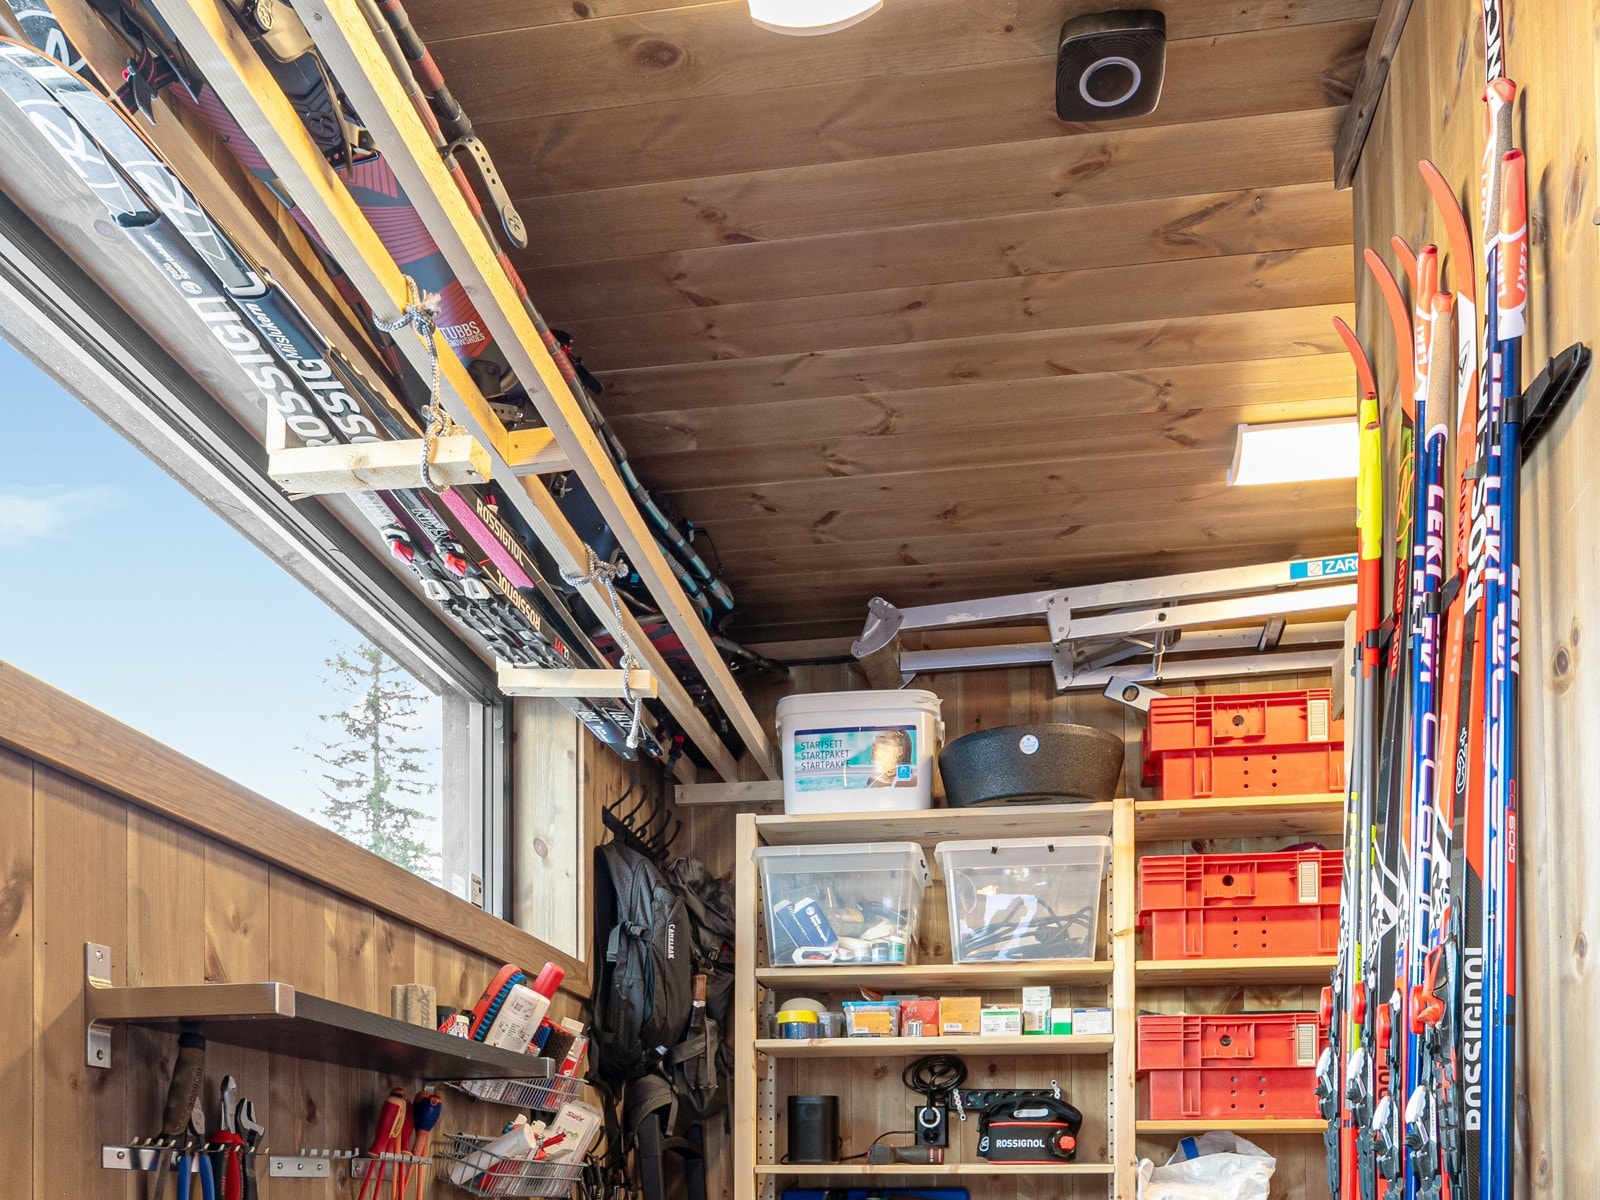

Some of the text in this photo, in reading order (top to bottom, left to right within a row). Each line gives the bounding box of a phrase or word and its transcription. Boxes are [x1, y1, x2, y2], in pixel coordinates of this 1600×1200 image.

[476, 497, 526, 566] ROSSIGNOL
[1424, 484, 1444, 579] LEKI
[800, 739, 843, 750] STARTSETT
[801, 749, 850, 760] STARTPAKET
[801, 759, 851, 771] STARTPAKKE
[667, 923, 676, 960] CAMELBAK
[996, 1138, 1046, 1150] ROSSIGNOL
